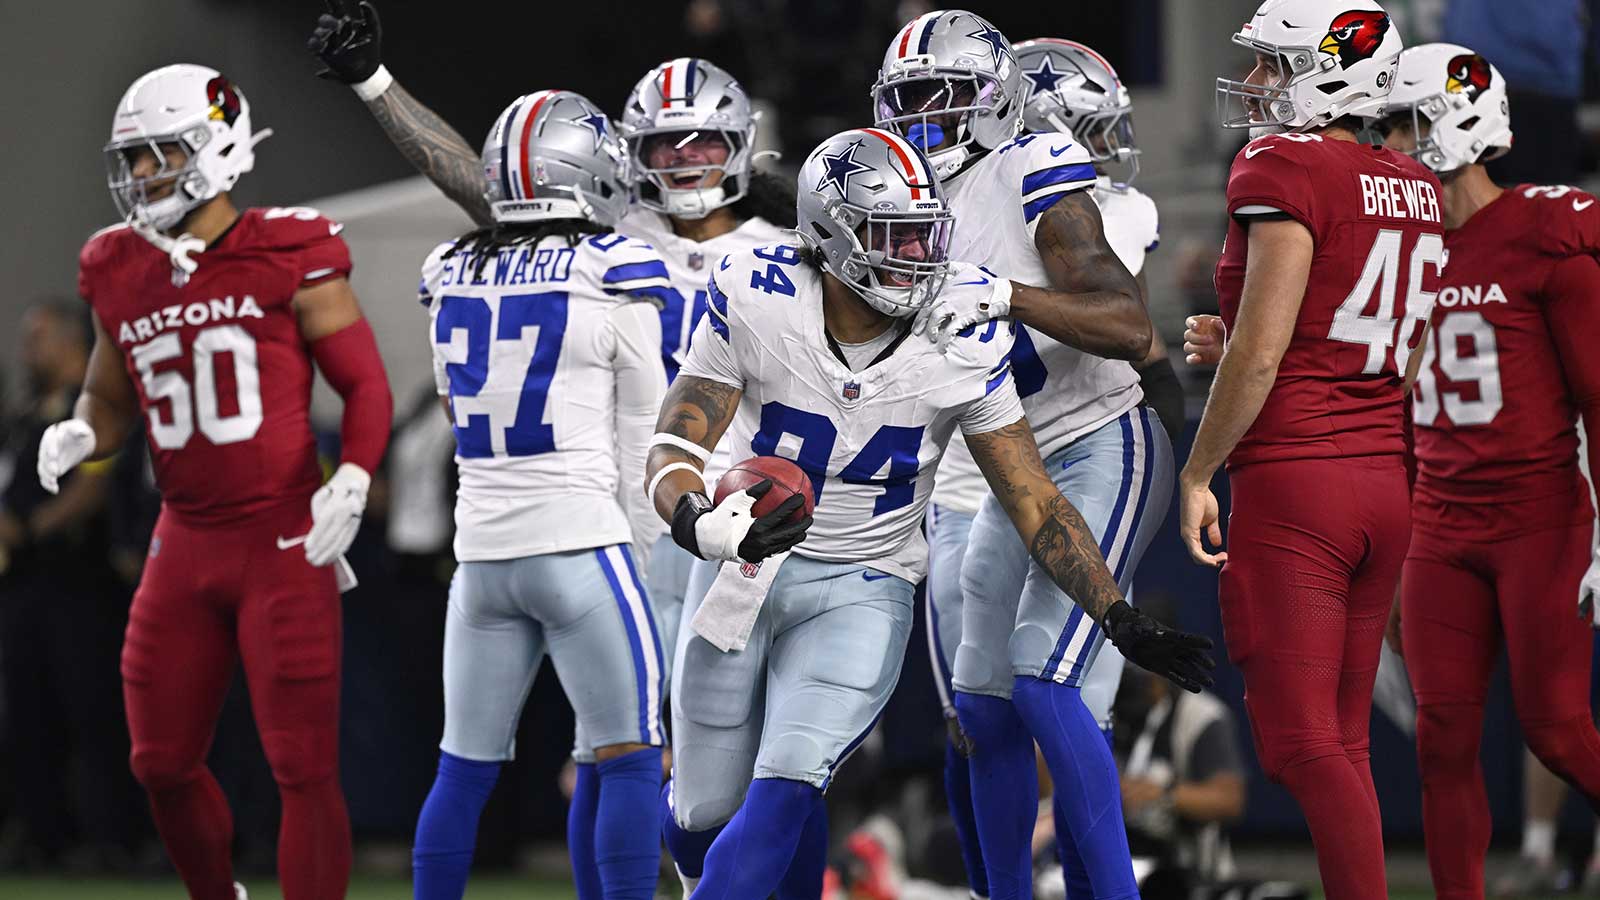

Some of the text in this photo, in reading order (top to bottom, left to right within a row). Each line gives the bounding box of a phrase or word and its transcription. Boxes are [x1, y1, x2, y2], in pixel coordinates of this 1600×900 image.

[1359, 174, 1441, 223] BREWER
[442, 248, 577, 287] STEWARD
[750, 245, 801, 297] 94
[1327, 229, 1444, 378] 46
[119, 295, 264, 344] ARIZONA
[131, 324, 264, 449] 50
[436, 291, 569, 458] 27
[751, 401, 926, 517] 94
